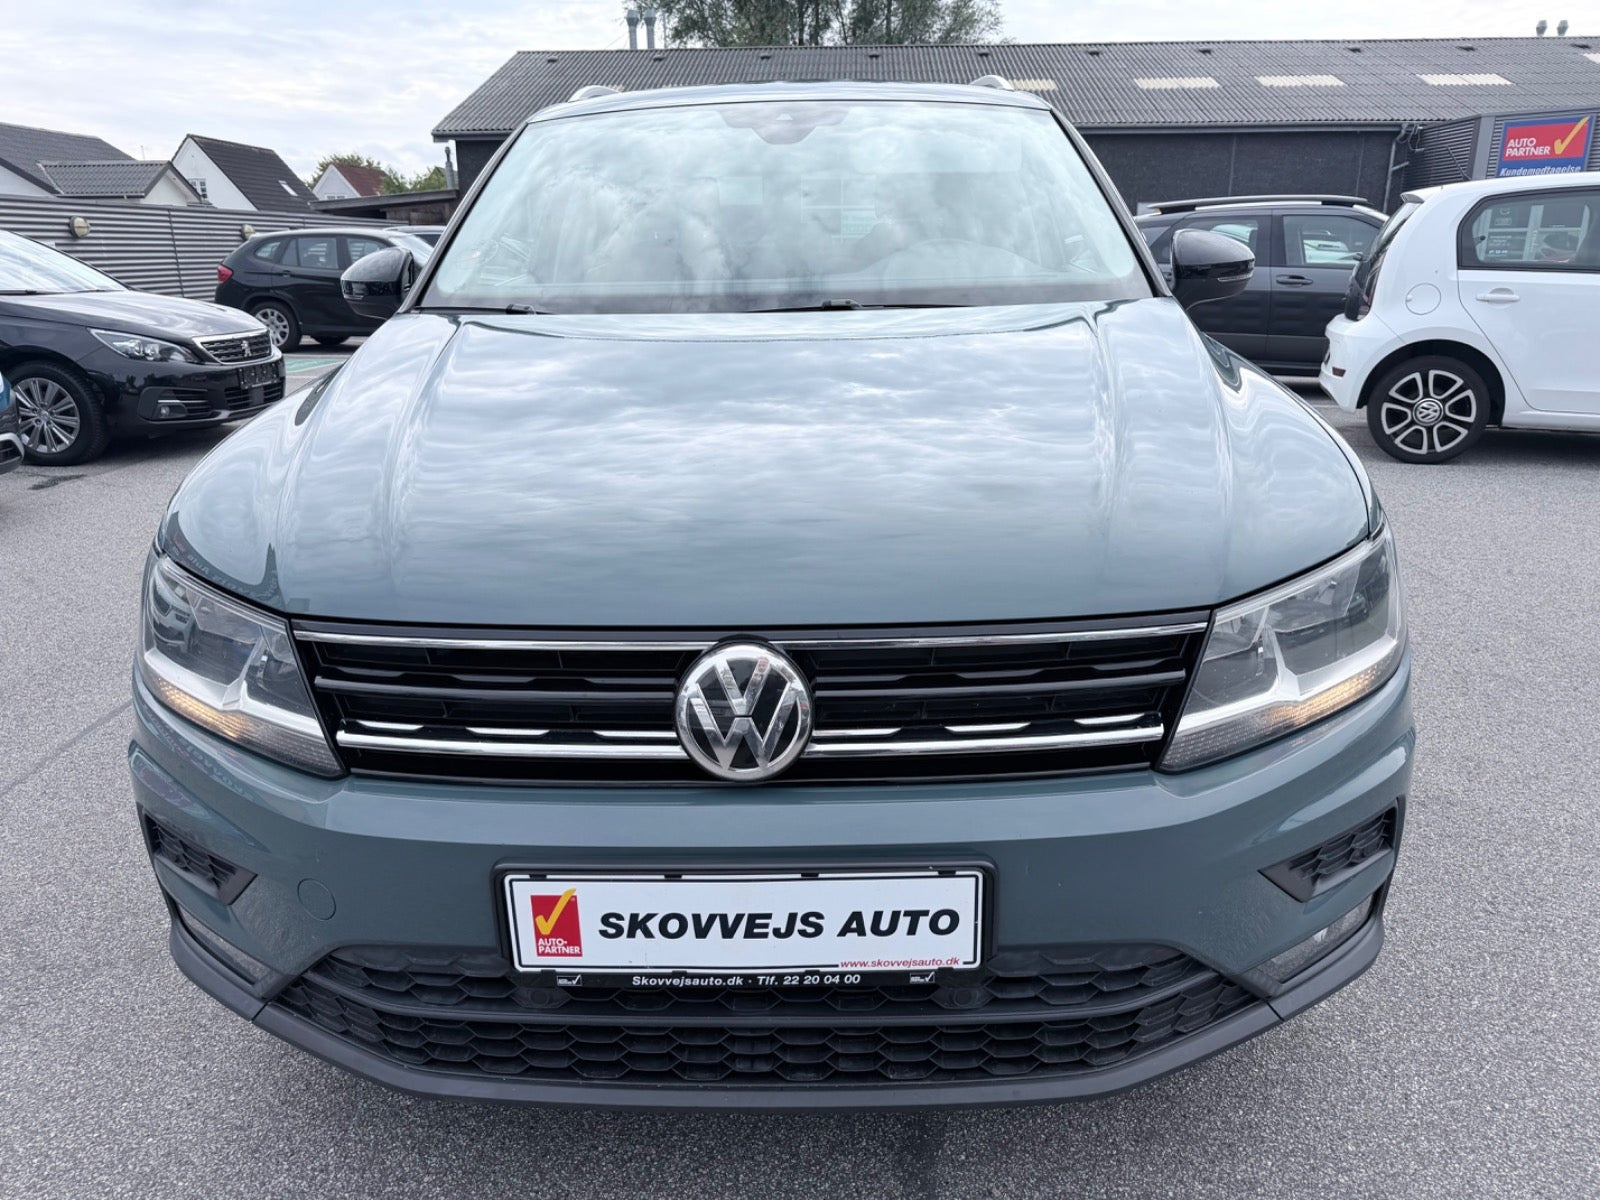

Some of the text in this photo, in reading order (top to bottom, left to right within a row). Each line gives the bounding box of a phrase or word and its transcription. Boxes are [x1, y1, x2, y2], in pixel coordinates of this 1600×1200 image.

[1507, 137, 1537, 148] AUTO
[1505, 146, 1551, 157] PARTNER
[598, 908, 960, 940] SKOVVEJS AUTO
[538, 946, 581, 954] PARTNER
[840, 957, 960, 969] www.skovvejsauto.dk
[632, 976, 744, 987] Skovvejsauto.dk
[783, 975, 800, 985] 22
[803, 975, 820, 985] 20
[824, 975, 840, 985] 04
[844, 974, 861, 984] 00
